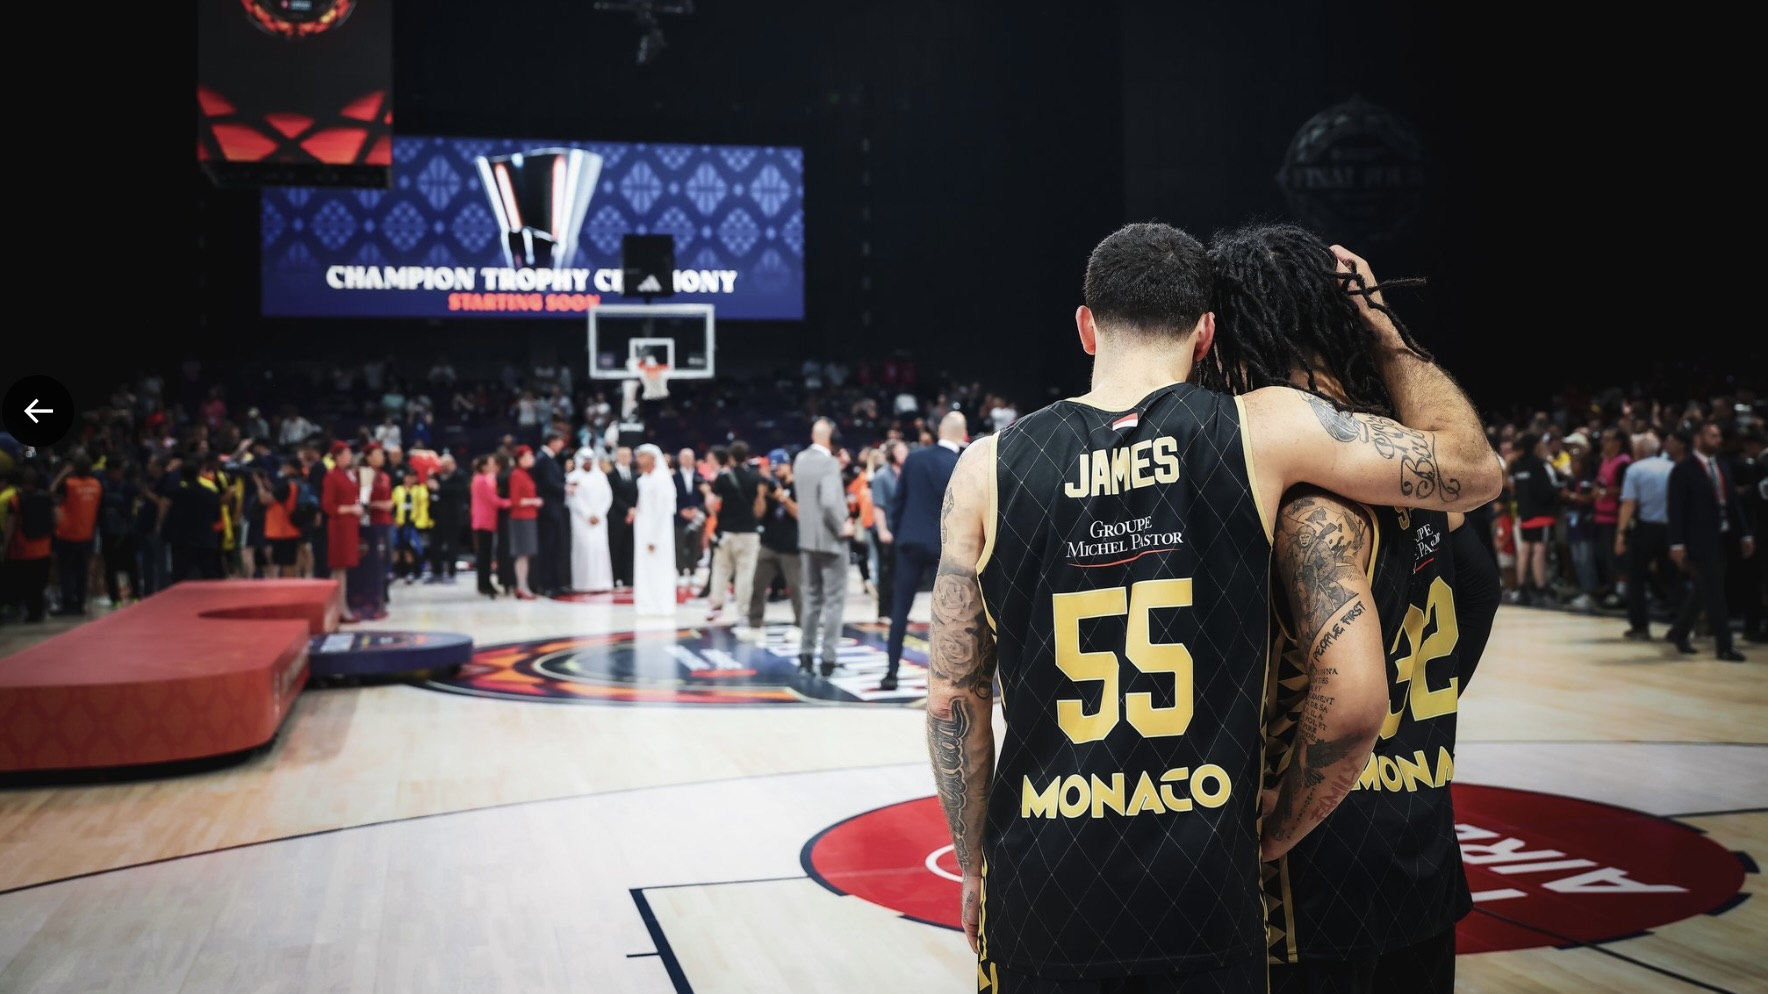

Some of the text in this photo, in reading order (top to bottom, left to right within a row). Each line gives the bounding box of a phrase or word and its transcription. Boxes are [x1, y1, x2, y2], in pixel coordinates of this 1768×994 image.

[326, 265, 476, 290] CHAMPION
[480, 267, 590, 292] TROPHY
[448, 292, 543, 311] STARTING
[1064, 435, 1180, 498] JAMES
[1340, 600, 1366, 625] FIRST
[1052, 577, 1194, 744] 55
[1021, 763, 1232, 819] MONACO
